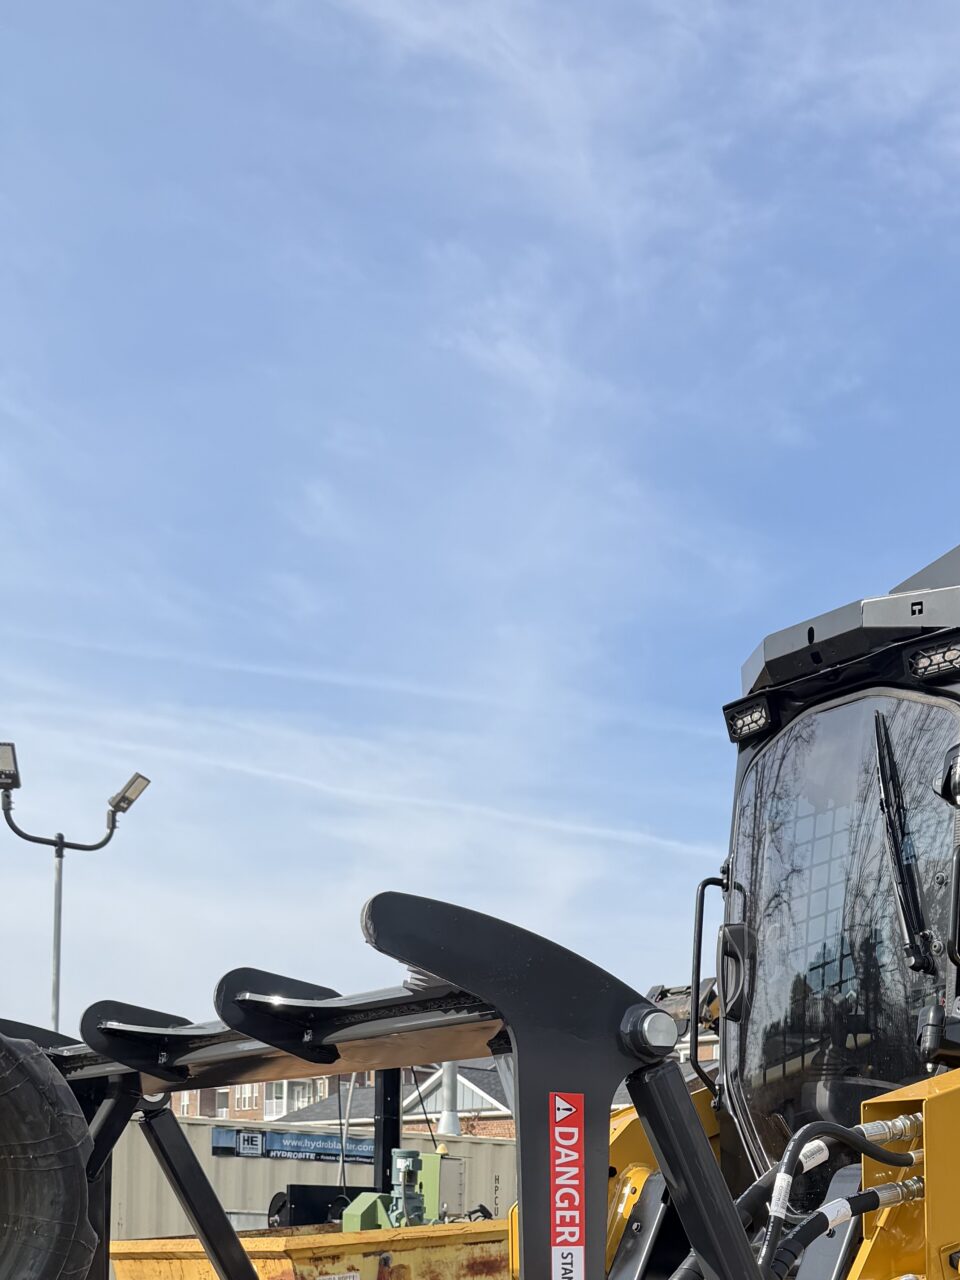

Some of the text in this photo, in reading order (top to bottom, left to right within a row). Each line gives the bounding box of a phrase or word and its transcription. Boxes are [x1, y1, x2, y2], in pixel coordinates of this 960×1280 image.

[243, 1135, 258, 1146] HE
[282, 1139, 375, 1152] www.hydroblater.com
[554, 1126, 580, 1244] DANGER
